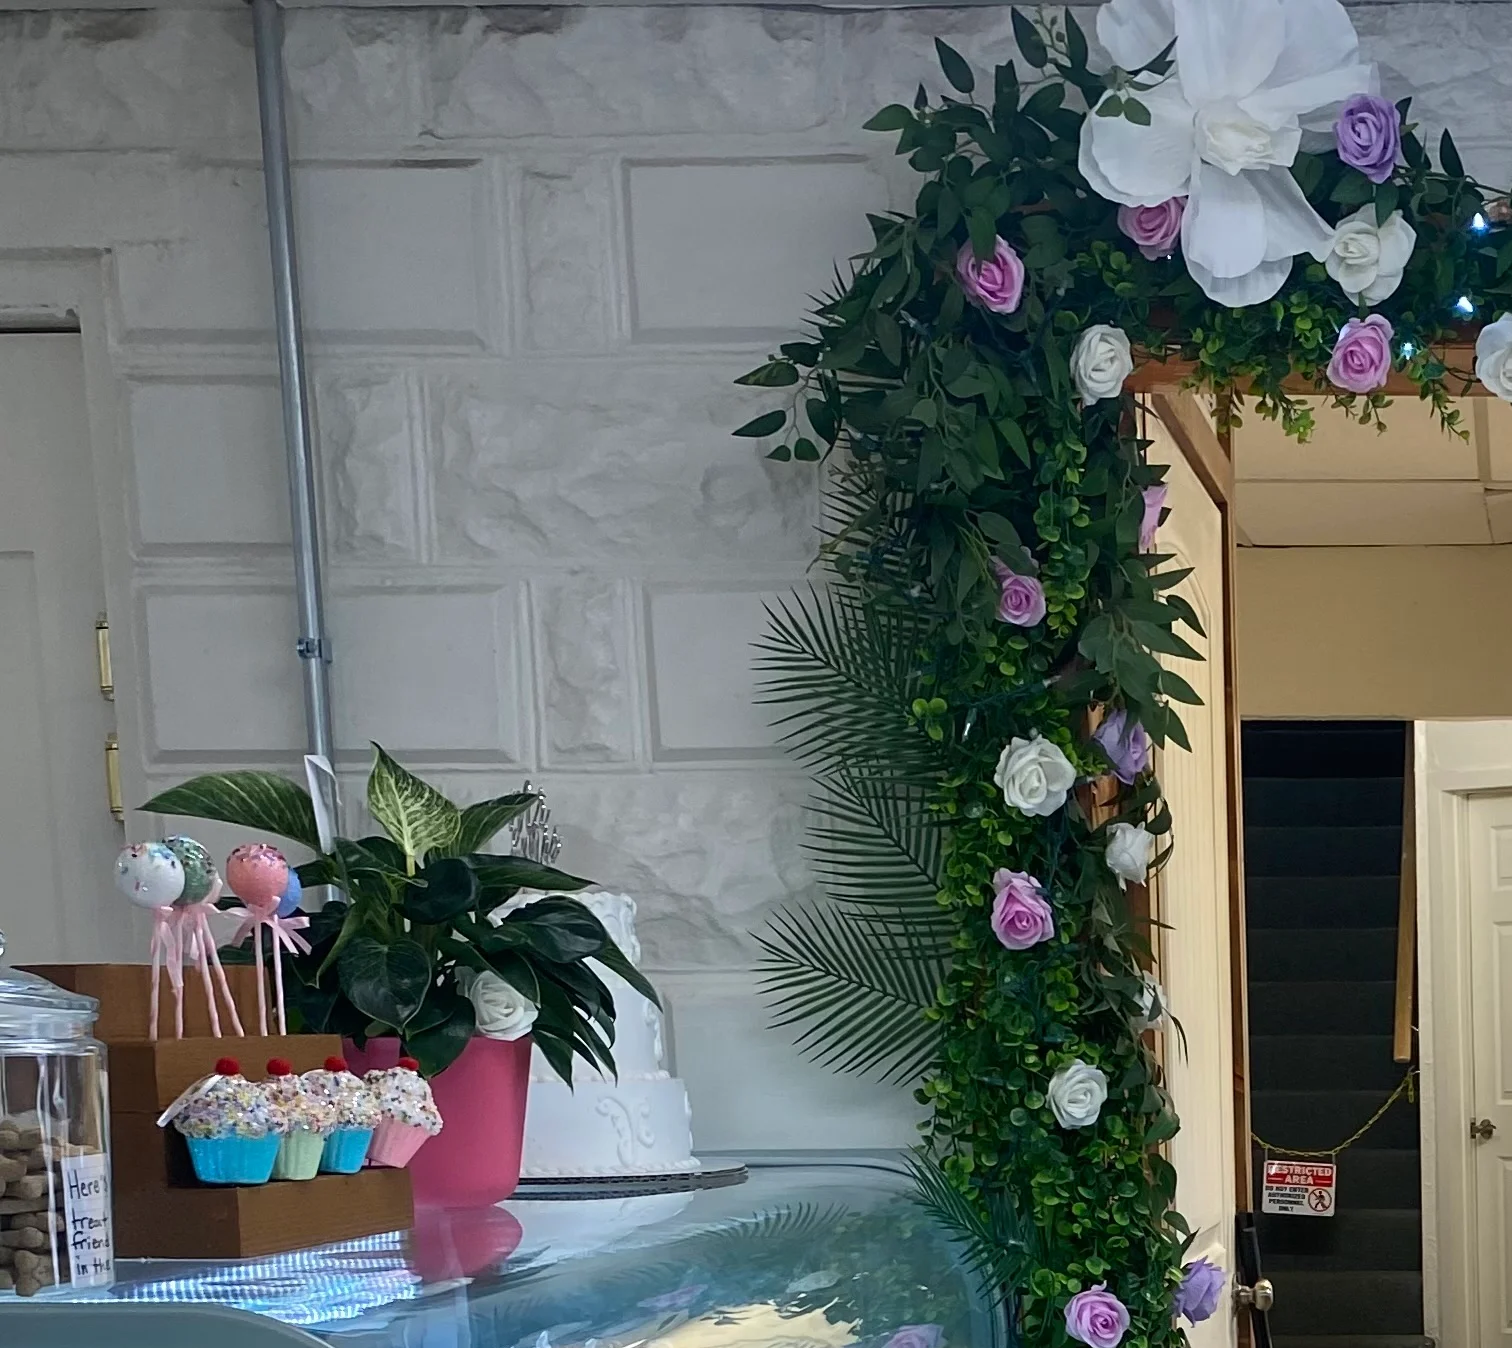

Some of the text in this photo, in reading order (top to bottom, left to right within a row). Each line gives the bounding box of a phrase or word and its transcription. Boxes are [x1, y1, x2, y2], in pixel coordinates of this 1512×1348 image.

[1267, 1164, 1332, 1177] RESTRICTED
[1284, 1175, 1314, 1185] AREA
[75, 1255, 89, 1276] in
